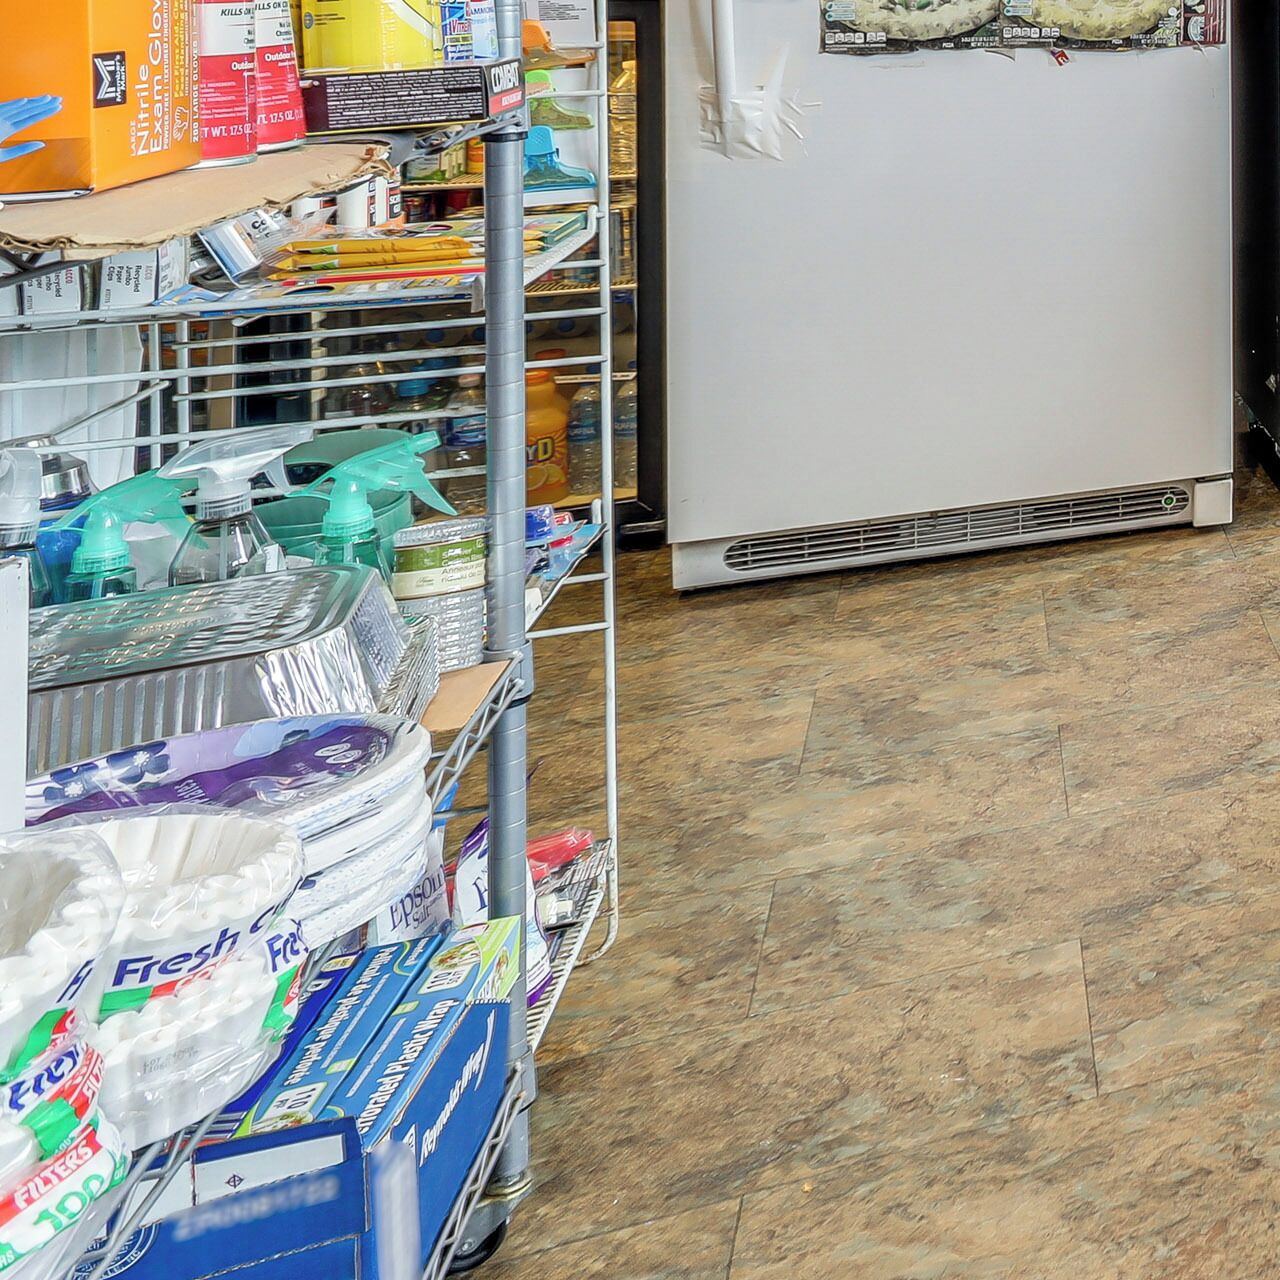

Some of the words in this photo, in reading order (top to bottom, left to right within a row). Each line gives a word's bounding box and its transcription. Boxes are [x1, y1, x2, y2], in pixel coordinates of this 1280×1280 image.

[135, 73, 151, 156] Nitrile
[149, 76, 163, 153] Exam
[412, 902, 433, 928] Salt
[111, 926, 241, 988] Fresh
[12, 1142, 95, 1210] FILTERS
[31, 1173, 106, 1234] 100
